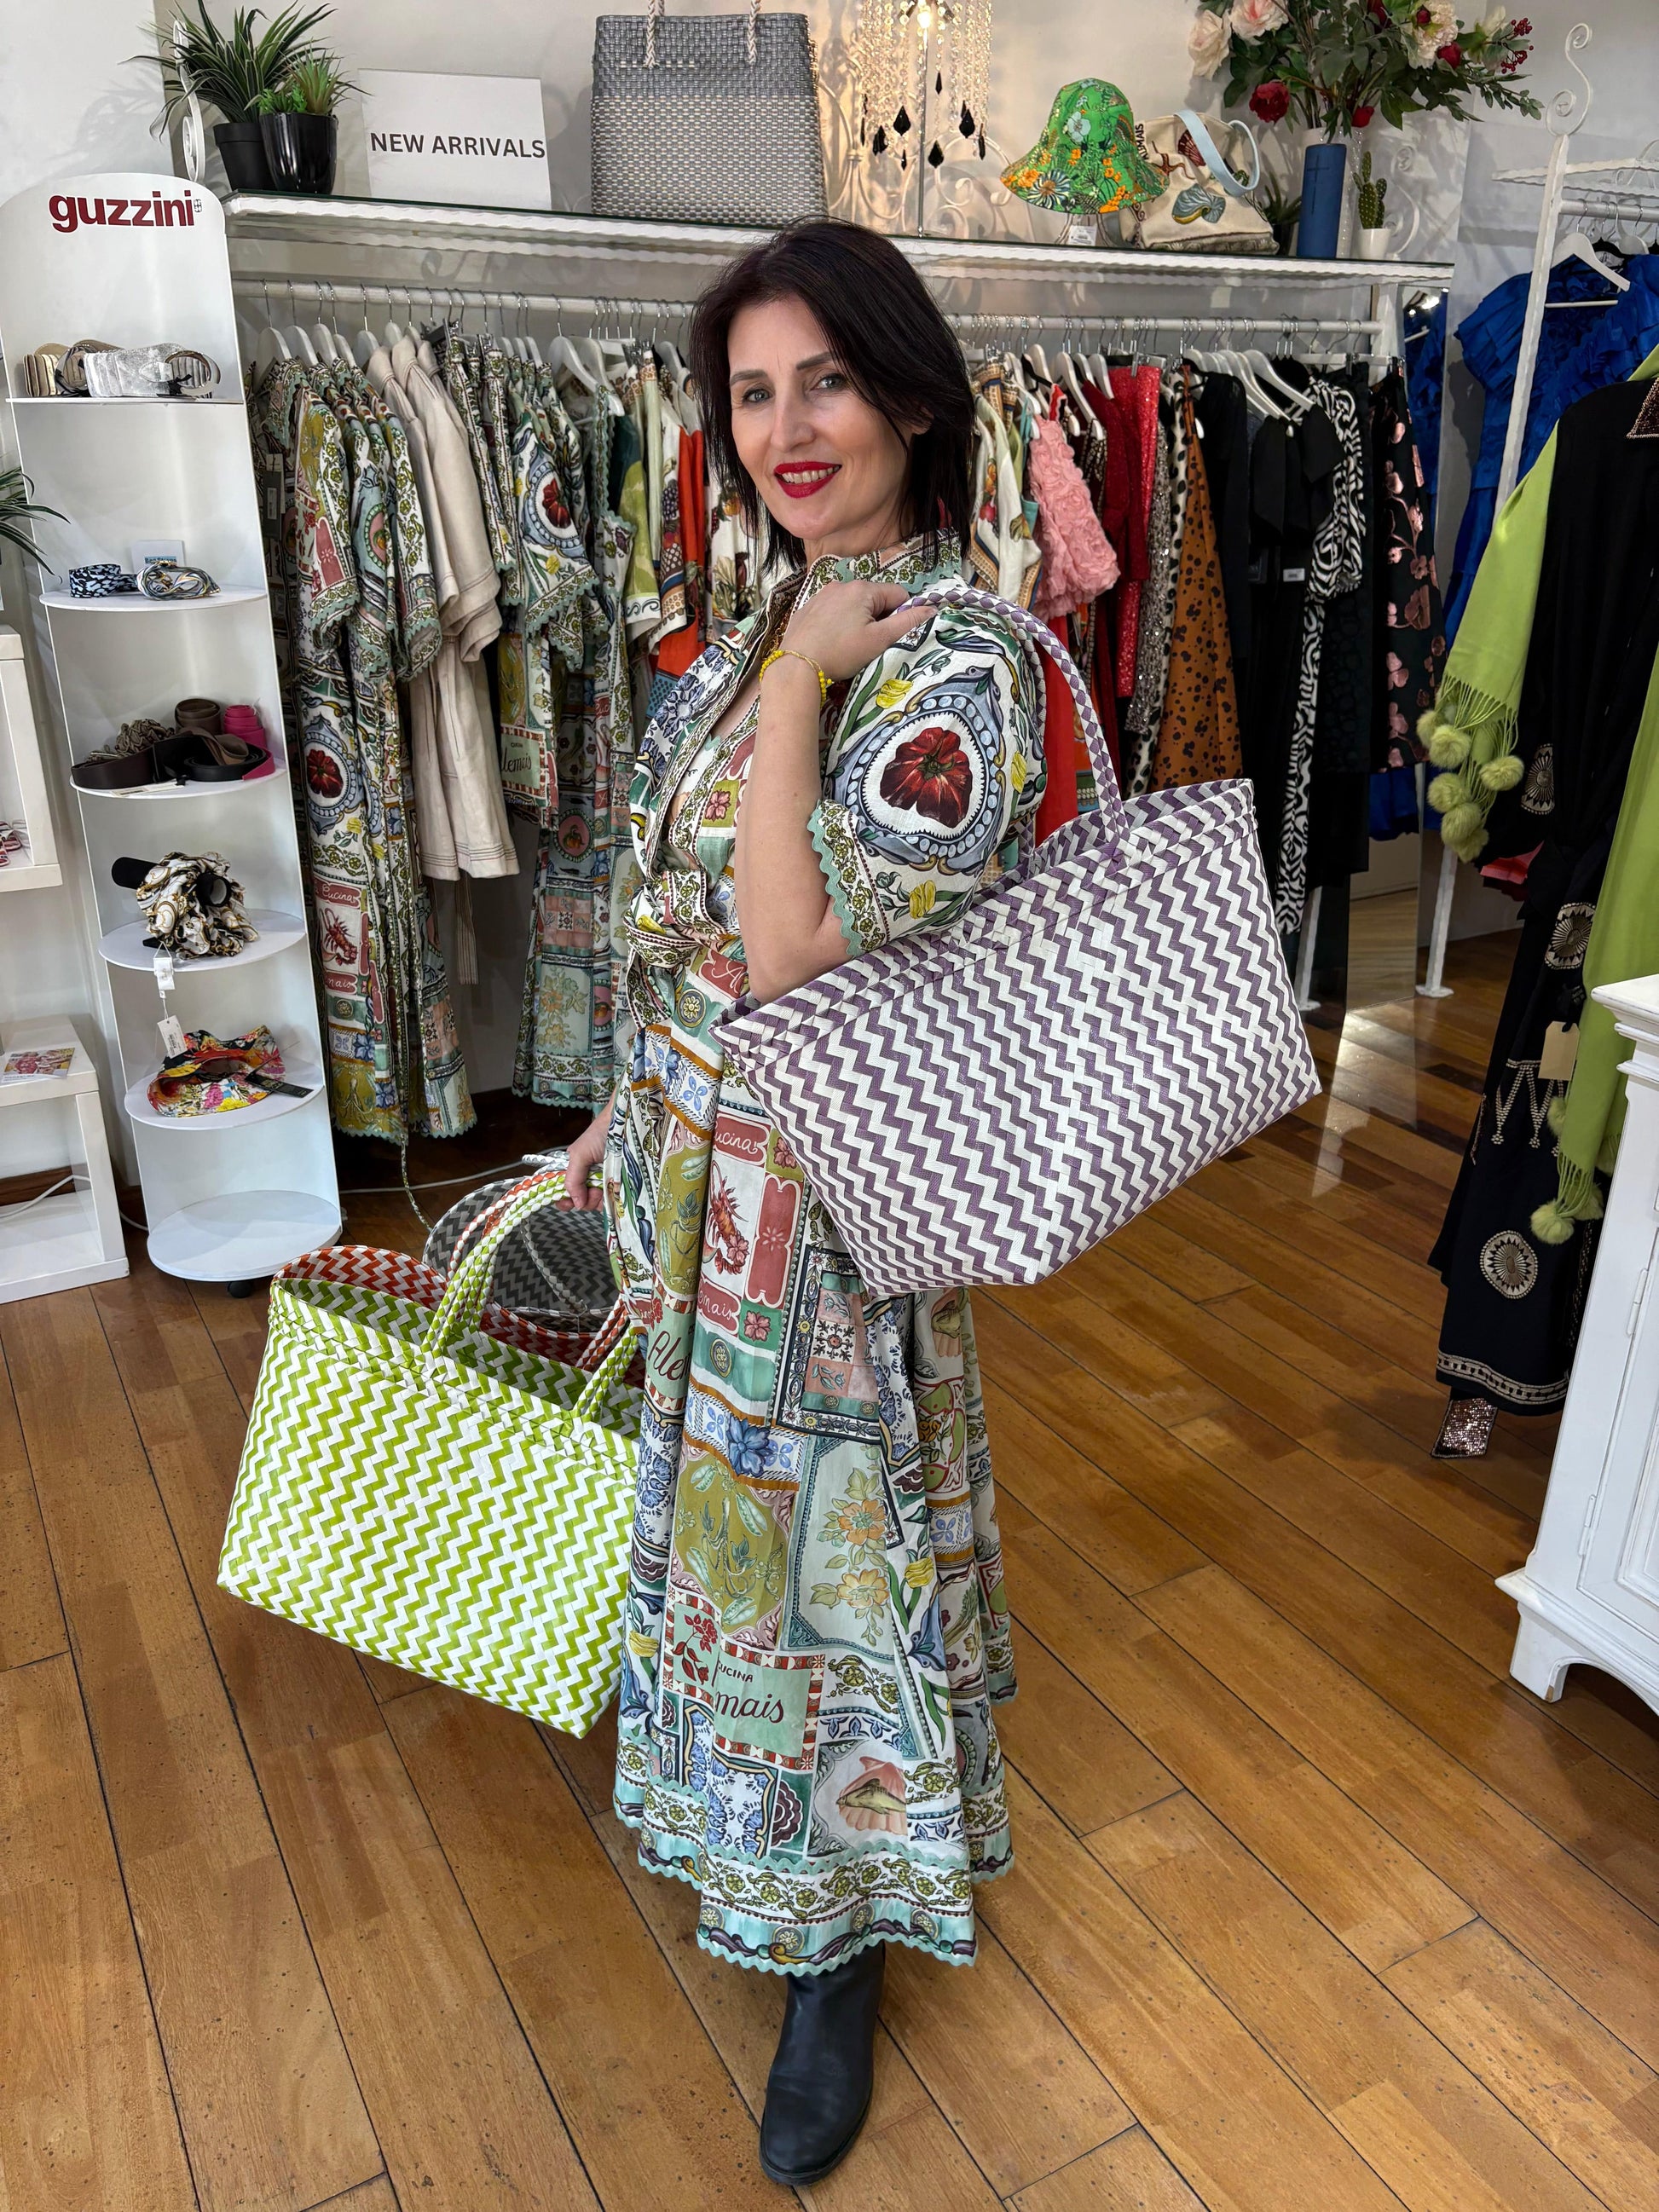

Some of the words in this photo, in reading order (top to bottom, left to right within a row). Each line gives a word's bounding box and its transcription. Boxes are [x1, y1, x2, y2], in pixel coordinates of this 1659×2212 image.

[370, 132, 424, 153] NEW
[431, 135, 546, 159] ARRIVALS
[49, 189, 194, 234] guzzini
[714, 1121, 759, 1154] ucina
[714, 1690, 784, 1724] mais
